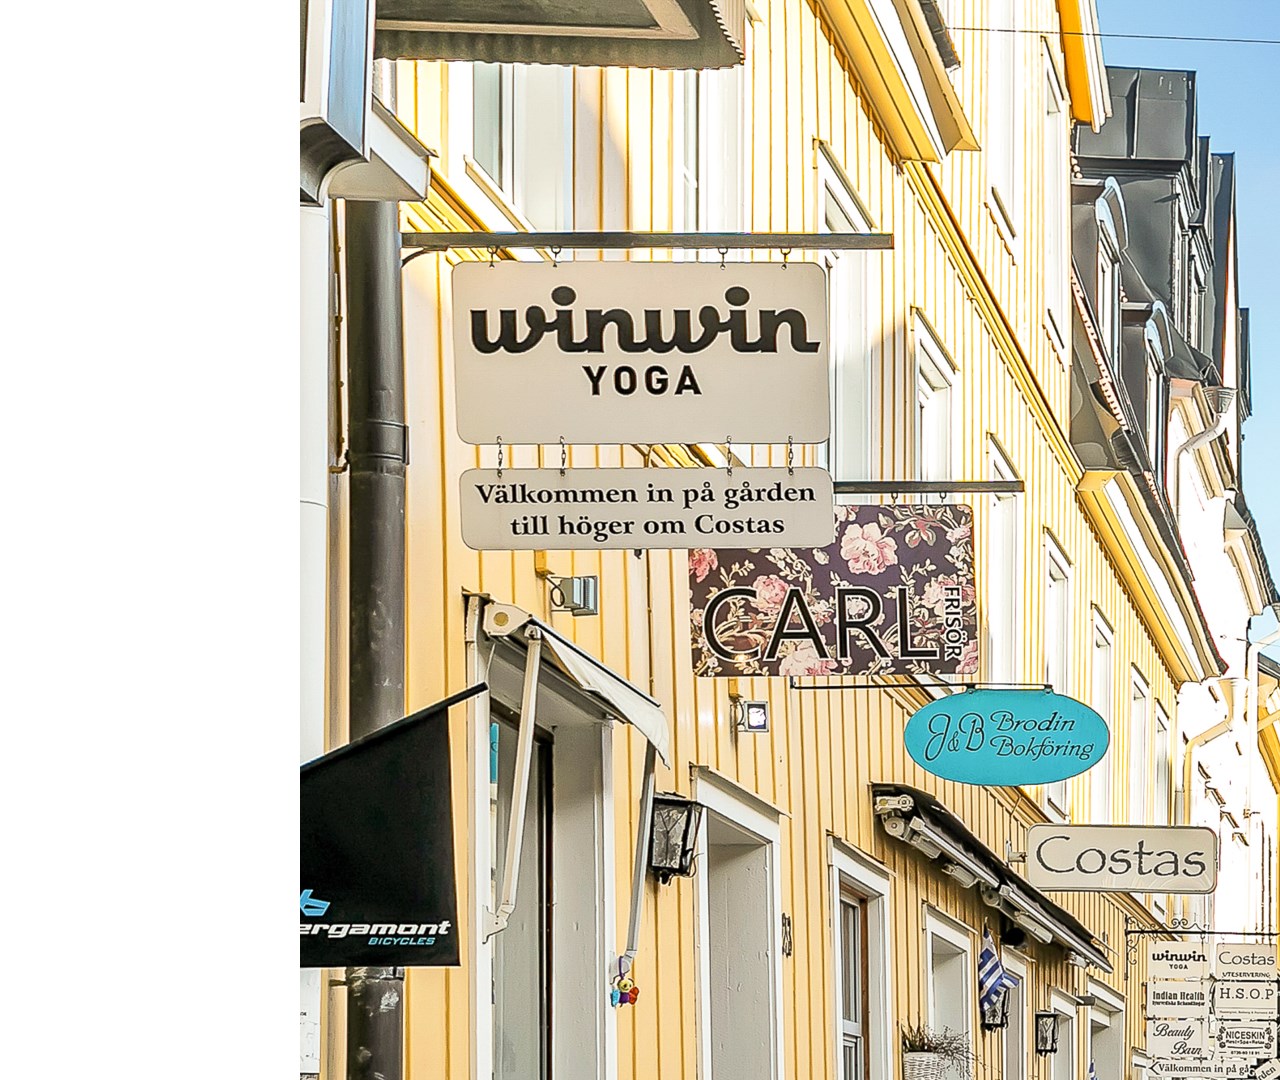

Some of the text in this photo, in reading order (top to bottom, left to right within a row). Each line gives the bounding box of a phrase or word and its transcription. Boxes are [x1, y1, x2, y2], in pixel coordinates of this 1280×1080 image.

[470, 285, 820, 353] winwin
[582, 365, 702, 396] YOGA
[475, 481, 816, 511] Välkommen in på gården
[510, 513, 785, 542] till höger om Costas
[701, 584, 940, 663] CARL
[944, 586, 968, 661] FRISÖR
[990, 711, 1076, 732] Brodin
[990, 735, 1095, 761] Bokföring
[1035, 835, 1207, 877] Costas
[300, 921, 451, 938] ergamont
[368, 937, 435, 945] BICYCLES
[1152, 950, 1207, 961] winwin
[1218, 951, 1275, 965] Costas
[1153, 991, 1205, 1001] Indian Health
[1153, 1023, 1195, 1041] Beauty
[1225, 1031, 1266, 1040] NICESKIN
[1159, 1062, 1211, 1073] Välkommen
[1214, 1064, 1223, 1073] in
[1226, 1063, 1237, 1076] på
[1239, 1064, 1249, 1076] gå
